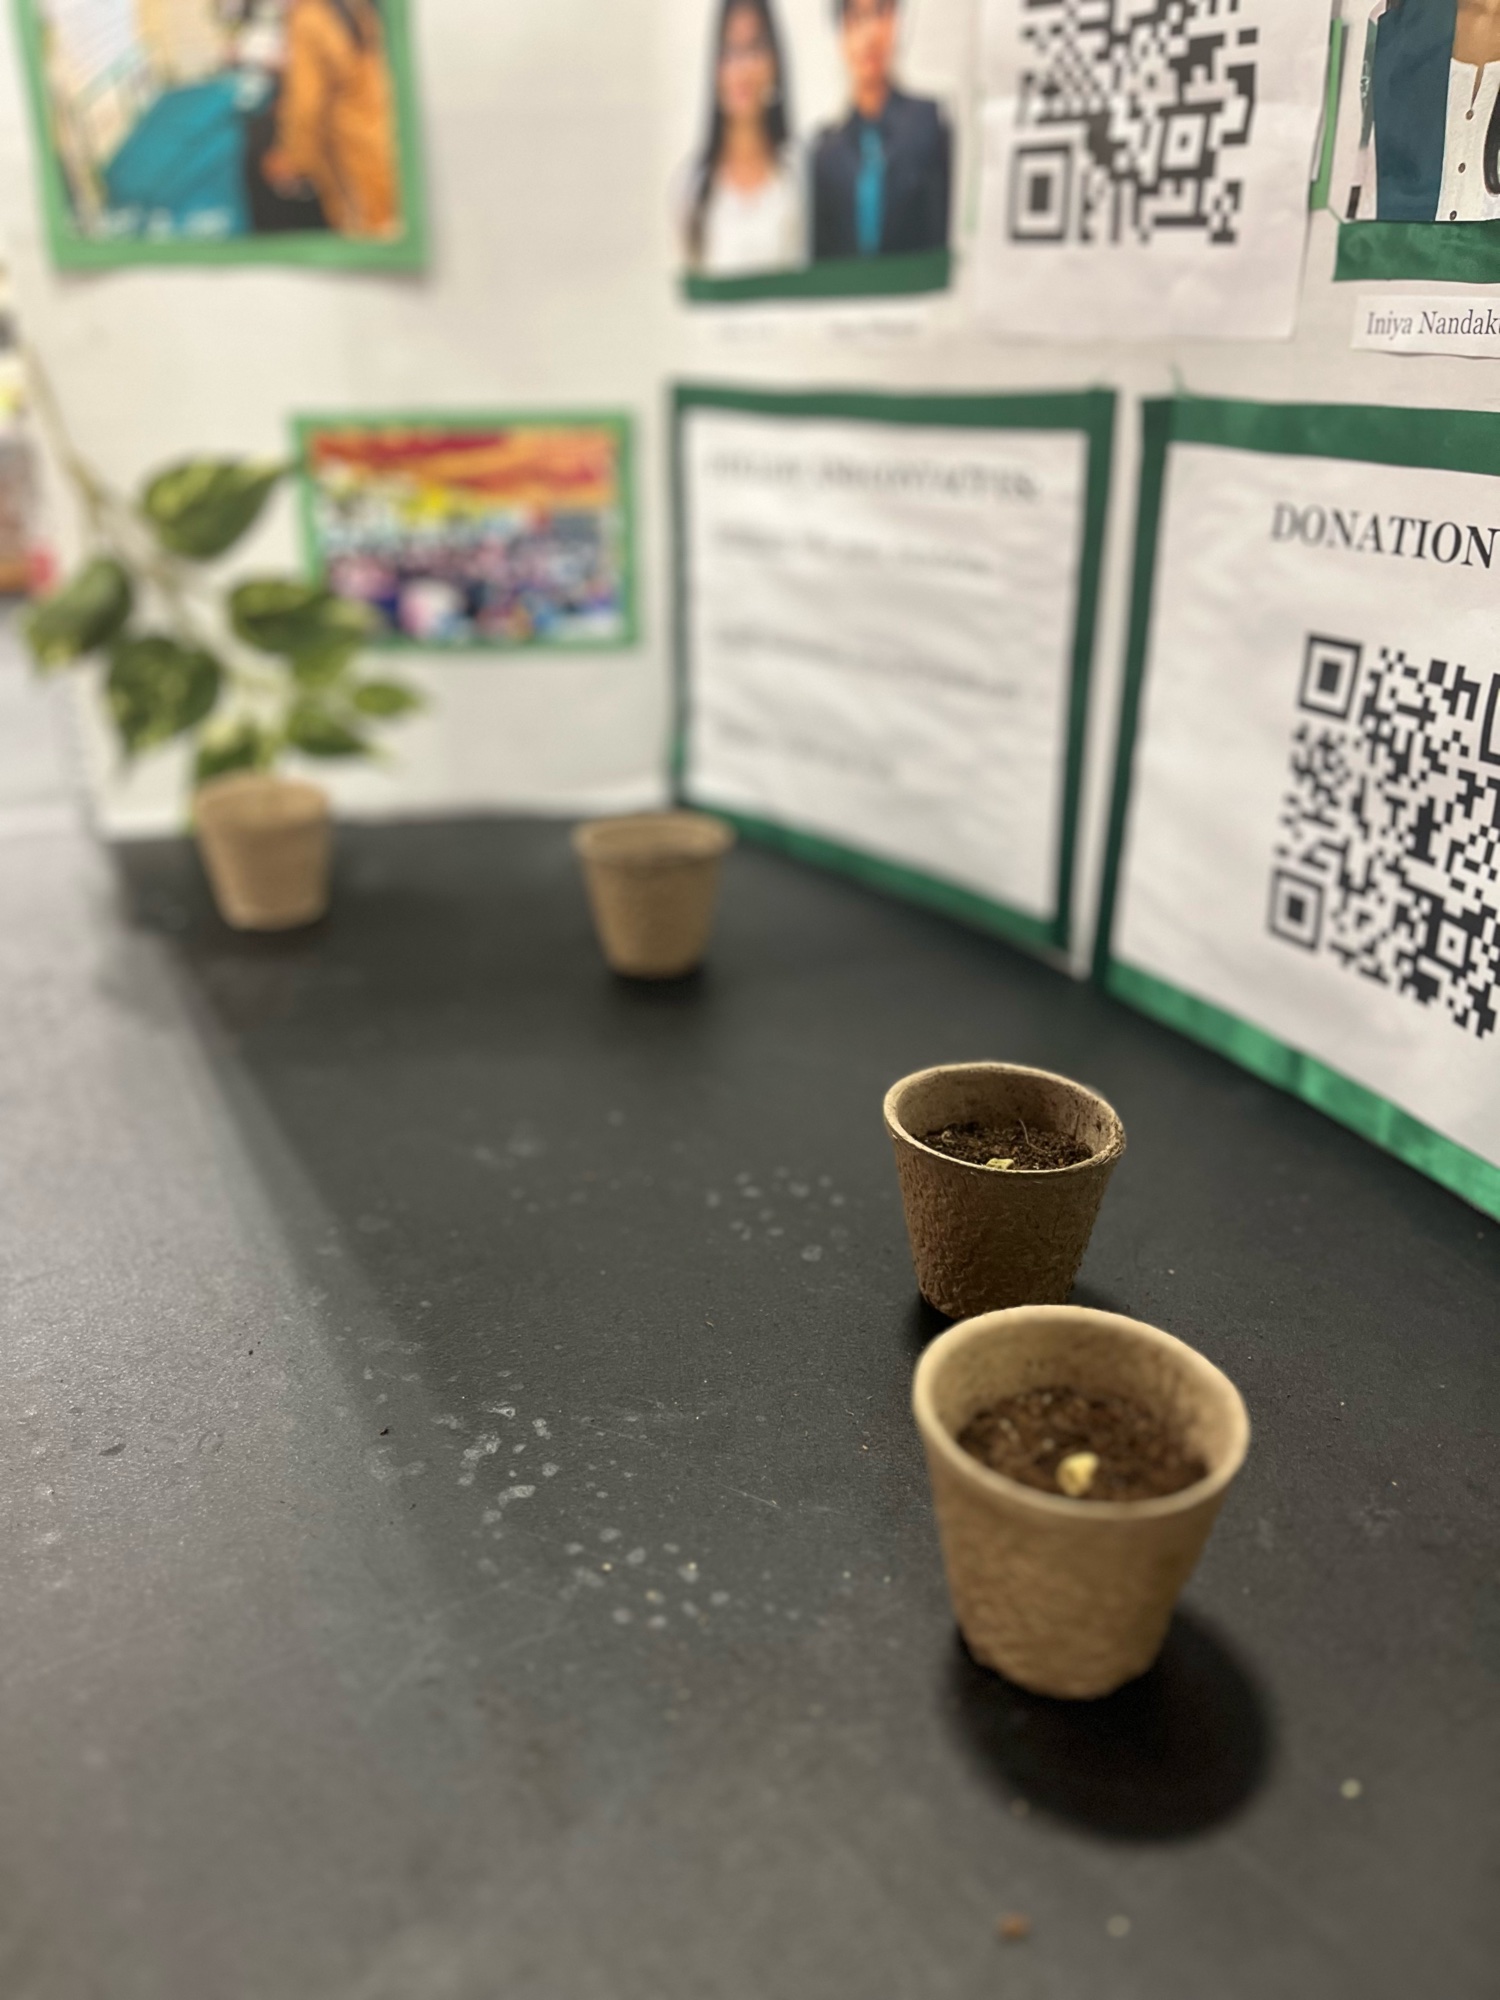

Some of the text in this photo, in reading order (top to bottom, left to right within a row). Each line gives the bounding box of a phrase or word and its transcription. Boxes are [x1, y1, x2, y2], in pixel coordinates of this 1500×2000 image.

[1366, 308, 1500, 341] Iniya Nandak
[1271, 501, 1500, 569] DONATION
